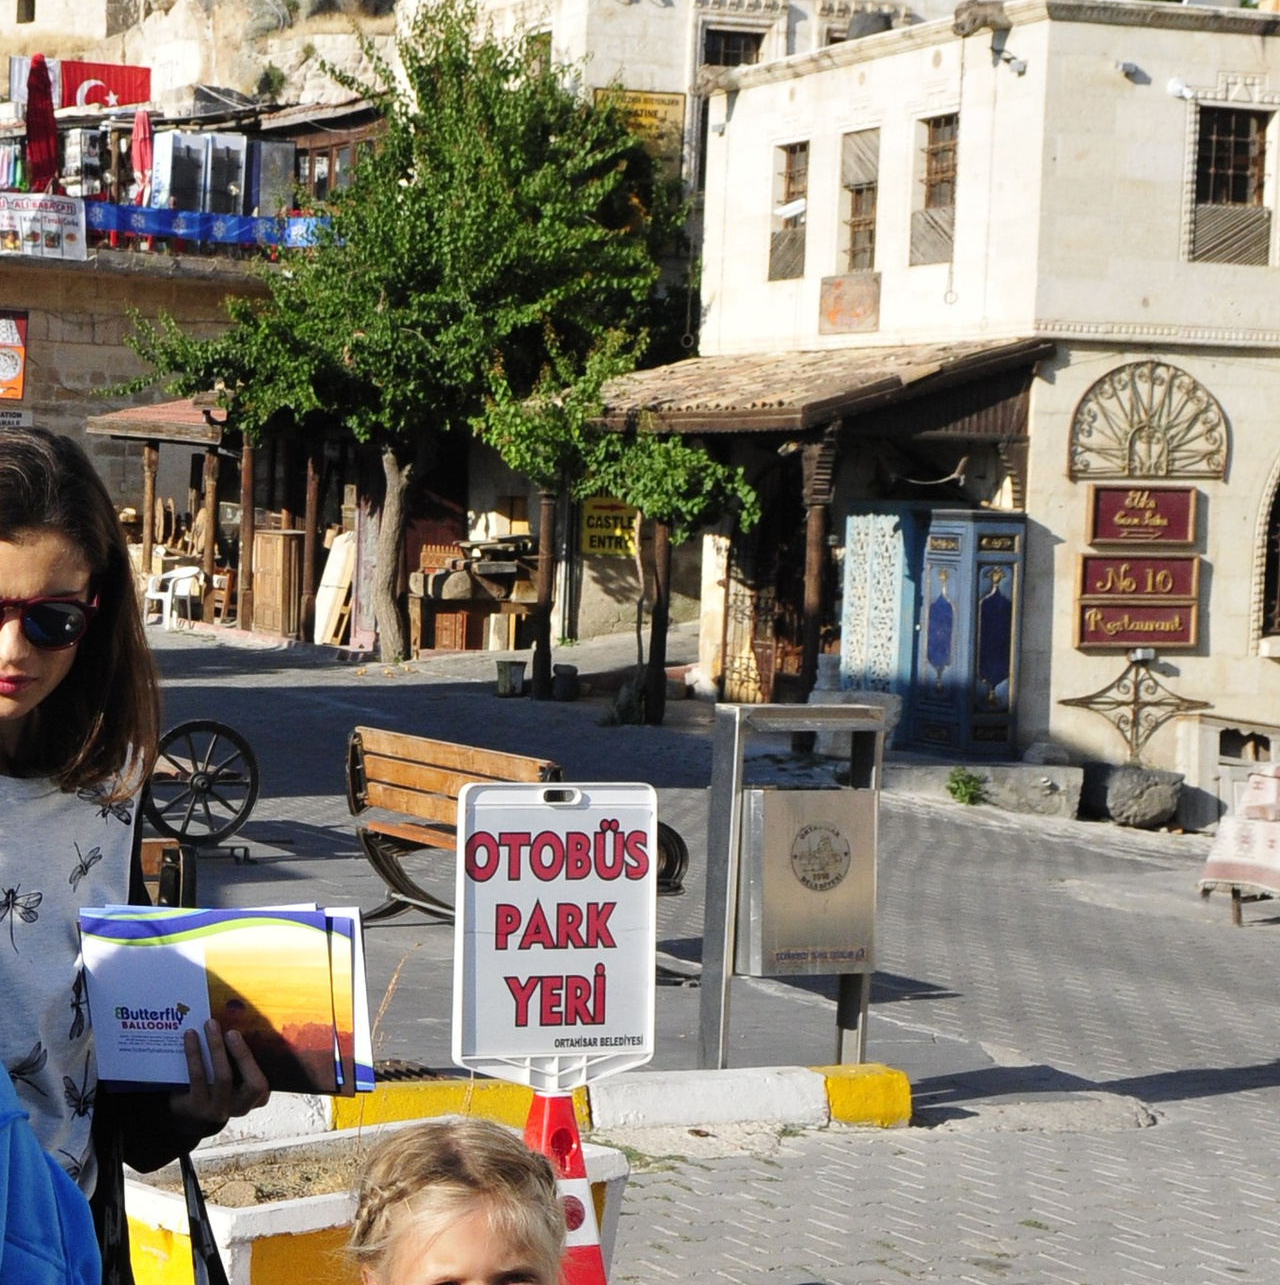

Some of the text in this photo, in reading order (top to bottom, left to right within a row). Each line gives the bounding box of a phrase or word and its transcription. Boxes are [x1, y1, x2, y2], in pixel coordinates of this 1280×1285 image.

[586, 515, 634, 530] CASTLE
[1095, 562, 1174, 593] No 10
[1085, 608, 1184, 636] Restaurant
[465, 818, 649, 882] OTOBÜS
[495, 898, 618, 950] PARK
[504, 962, 606, 1028] YERİ
[121, 1021, 179, 1030] BALLOONS
[554, 1034, 644, 1048] ORTAHİSAR BELEDİYESİ
